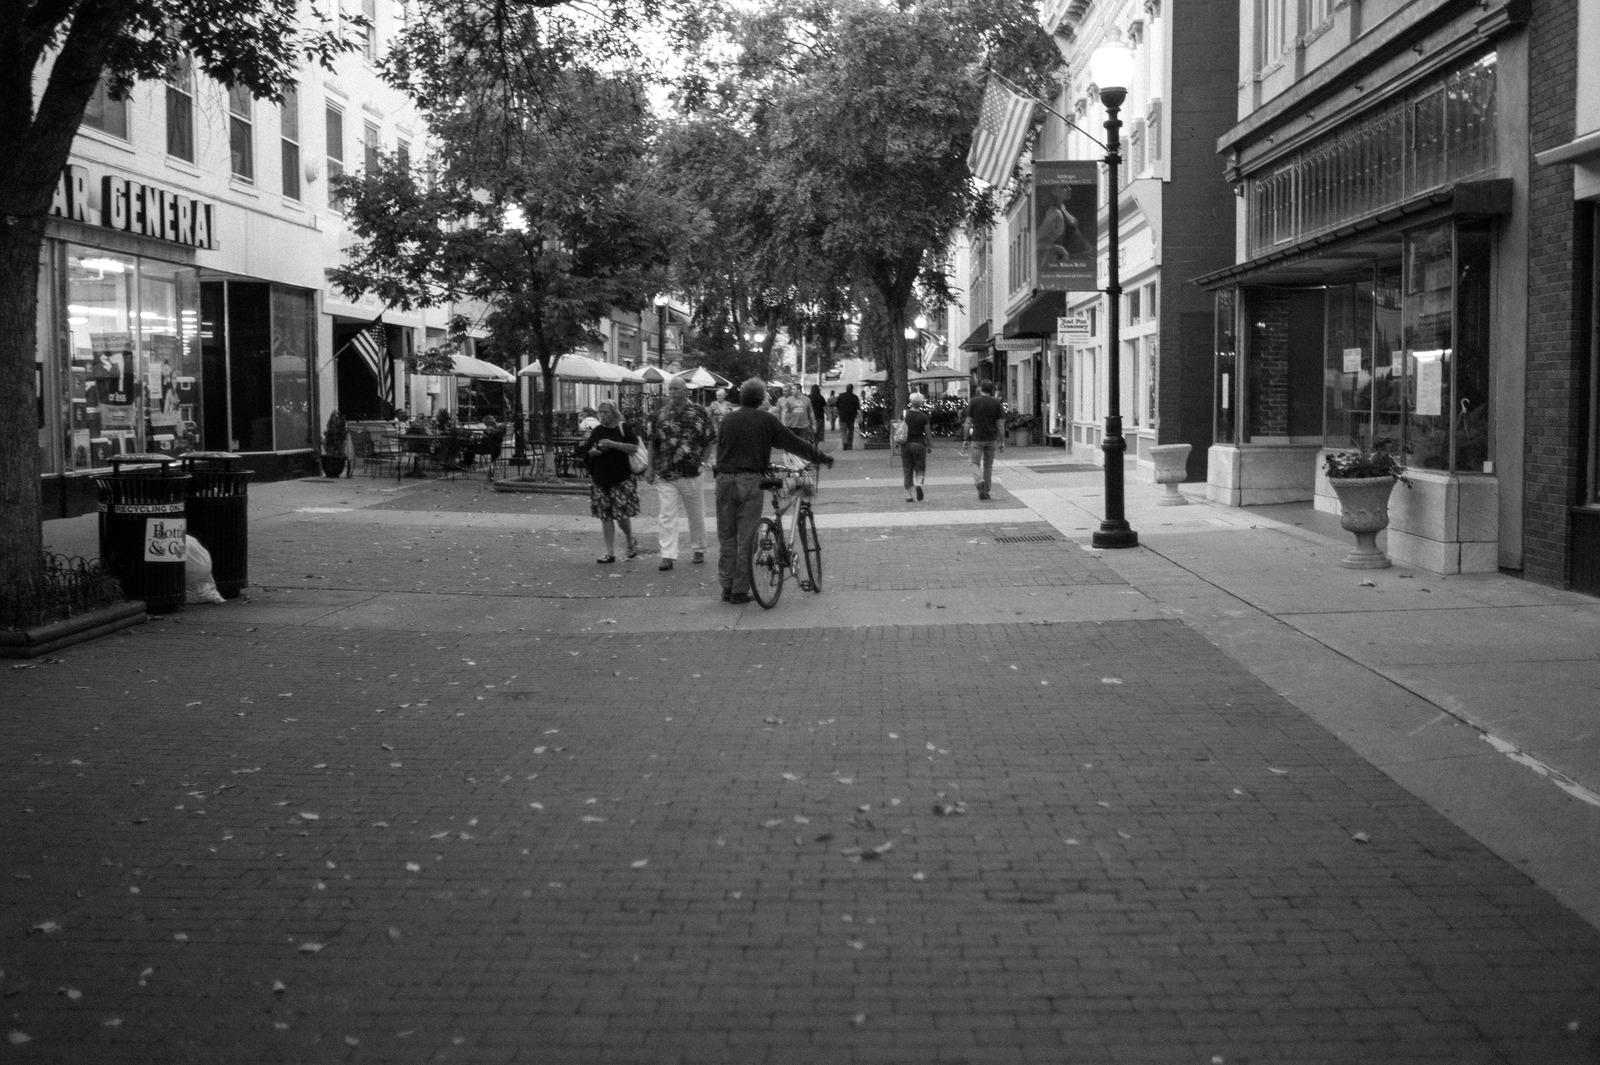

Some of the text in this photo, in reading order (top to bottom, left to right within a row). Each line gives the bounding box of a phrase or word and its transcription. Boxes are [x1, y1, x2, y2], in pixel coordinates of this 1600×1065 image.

[102, 175, 220, 251] GENERAL
[115, 391, 127, 402] less
[149, 540, 165, 555] &
